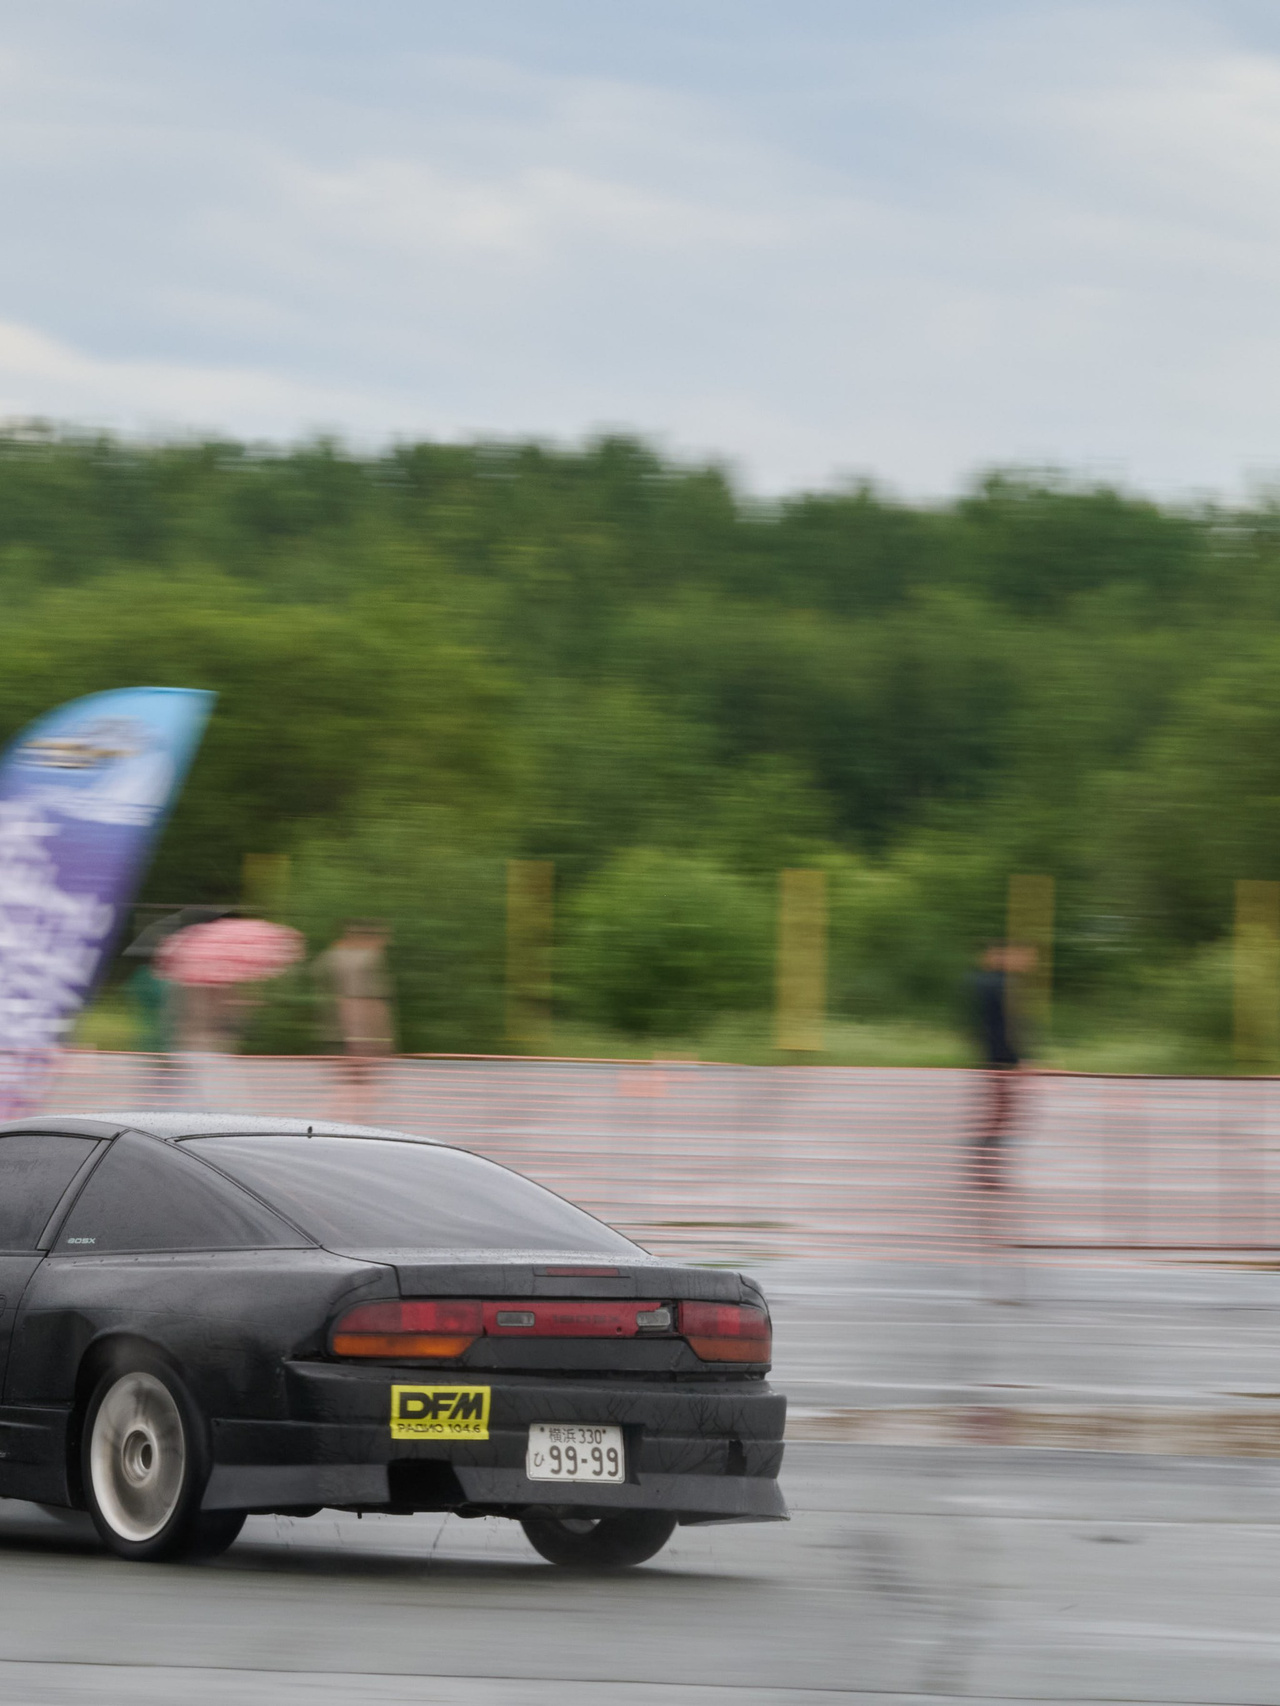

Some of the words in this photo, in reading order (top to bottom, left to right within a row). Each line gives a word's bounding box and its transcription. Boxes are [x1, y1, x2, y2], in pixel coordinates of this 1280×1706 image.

[399, 1392, 483, 1420] DFM
[448, 1423, 481, 1433] 104.6
[549, 1427, 576, 1443] 横浜
[578, 1428, 602, 1444] 330
[534, 1451, 545, 1467] ひ
[549, 1445, 619, 1477] 99-99
